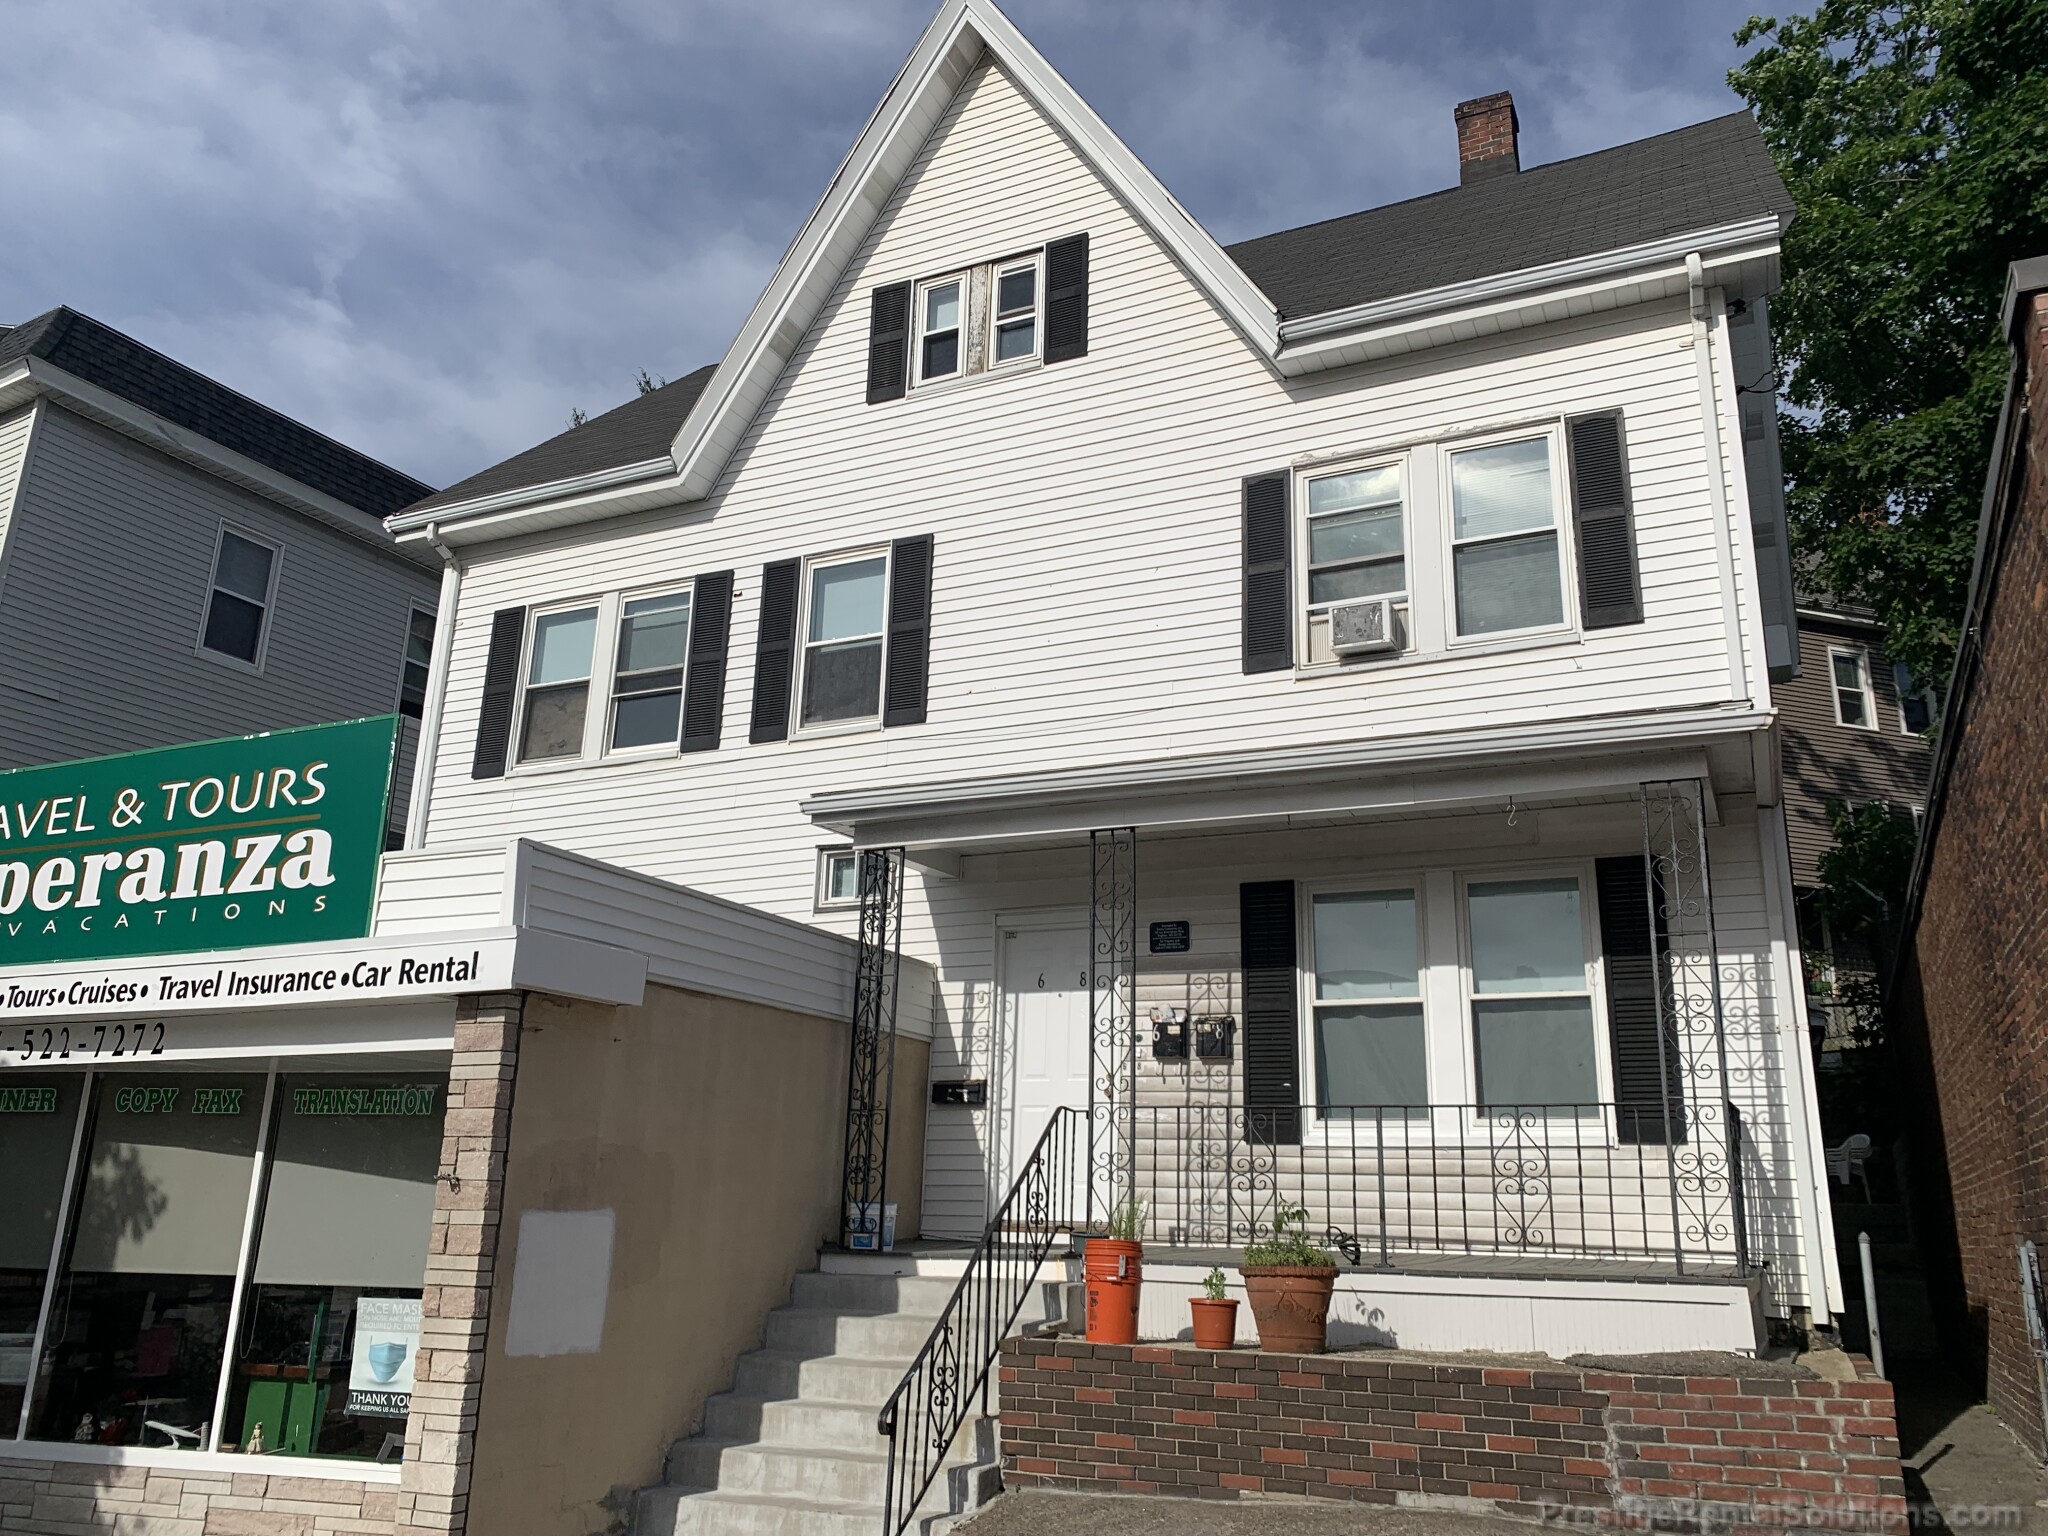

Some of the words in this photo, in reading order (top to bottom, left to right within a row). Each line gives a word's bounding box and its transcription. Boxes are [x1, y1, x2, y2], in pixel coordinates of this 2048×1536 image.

[112, 788, 145, 828] &
[160, 762, 329, 821] TOURS
[8, 895, 327, 937] VACATIONS
[158, 970, 223, 1001] Travel
[398, 951, 479, 985] Rental
[1037, 972, 1045, 989] 6
[1079, 971, 1087, 987] 8
[0, 1022, 165, 1061] -522-7272
[1152, 1024, 1161, 1042] 6
[1215, 1023, 1224, 1040] 8
[115, 1087, 179, 1113] COPY
[192, 1088, 243, 1114] FAX
[294, 1088, 435, 1115] TRANSLATION
[360, 1302, 390, 1314] FACE
[351, 1391, 388, 1406] THANK
